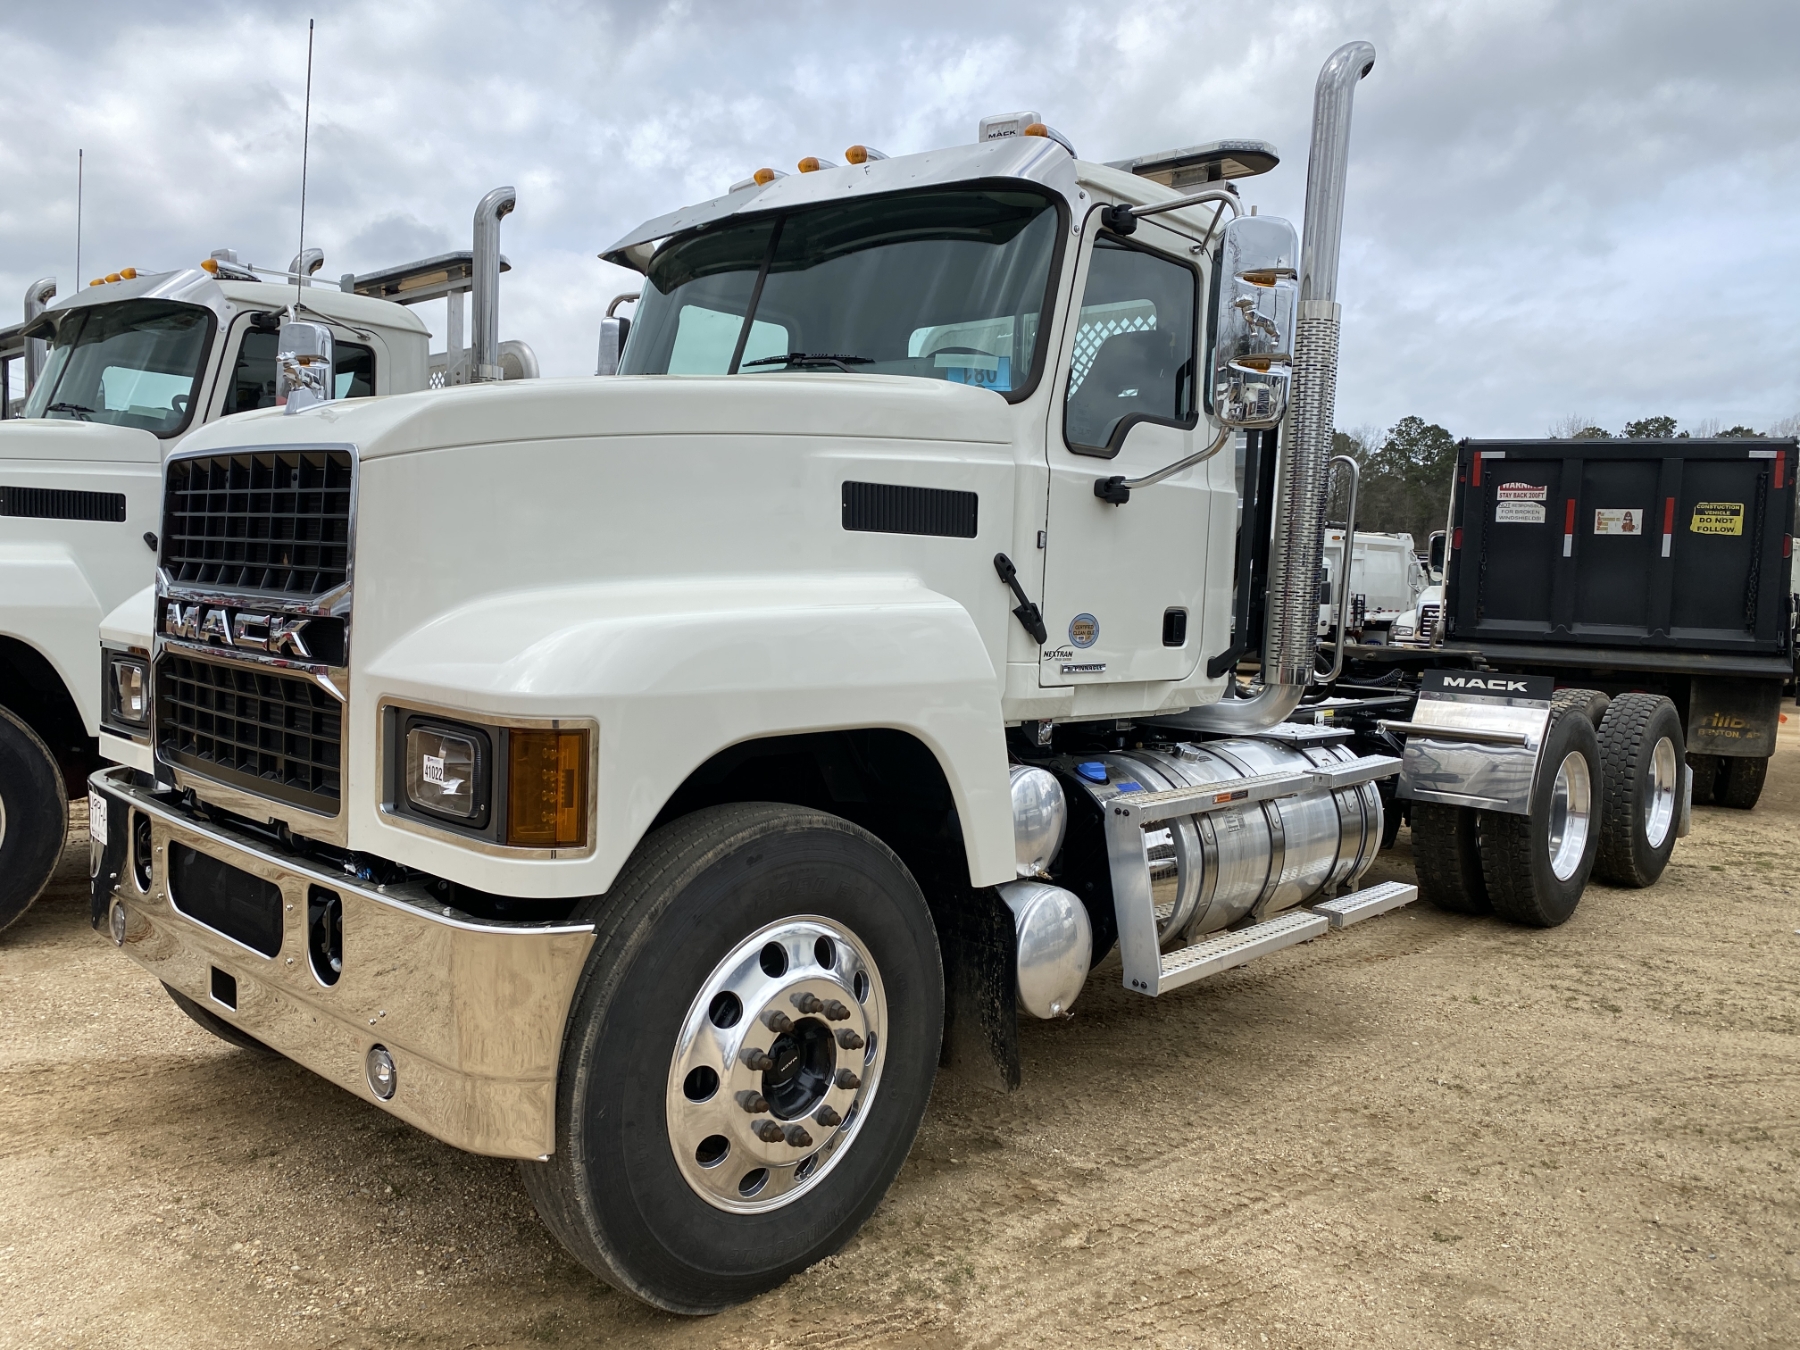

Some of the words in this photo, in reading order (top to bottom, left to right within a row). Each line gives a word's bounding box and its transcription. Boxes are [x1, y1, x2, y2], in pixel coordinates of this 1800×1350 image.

[988, 129, 1016, 139] MACK
[165, 602, 313, 658] MACK
[1443, 676, 1528, 693] MACK
[424, 764, 443, 782] 41022
